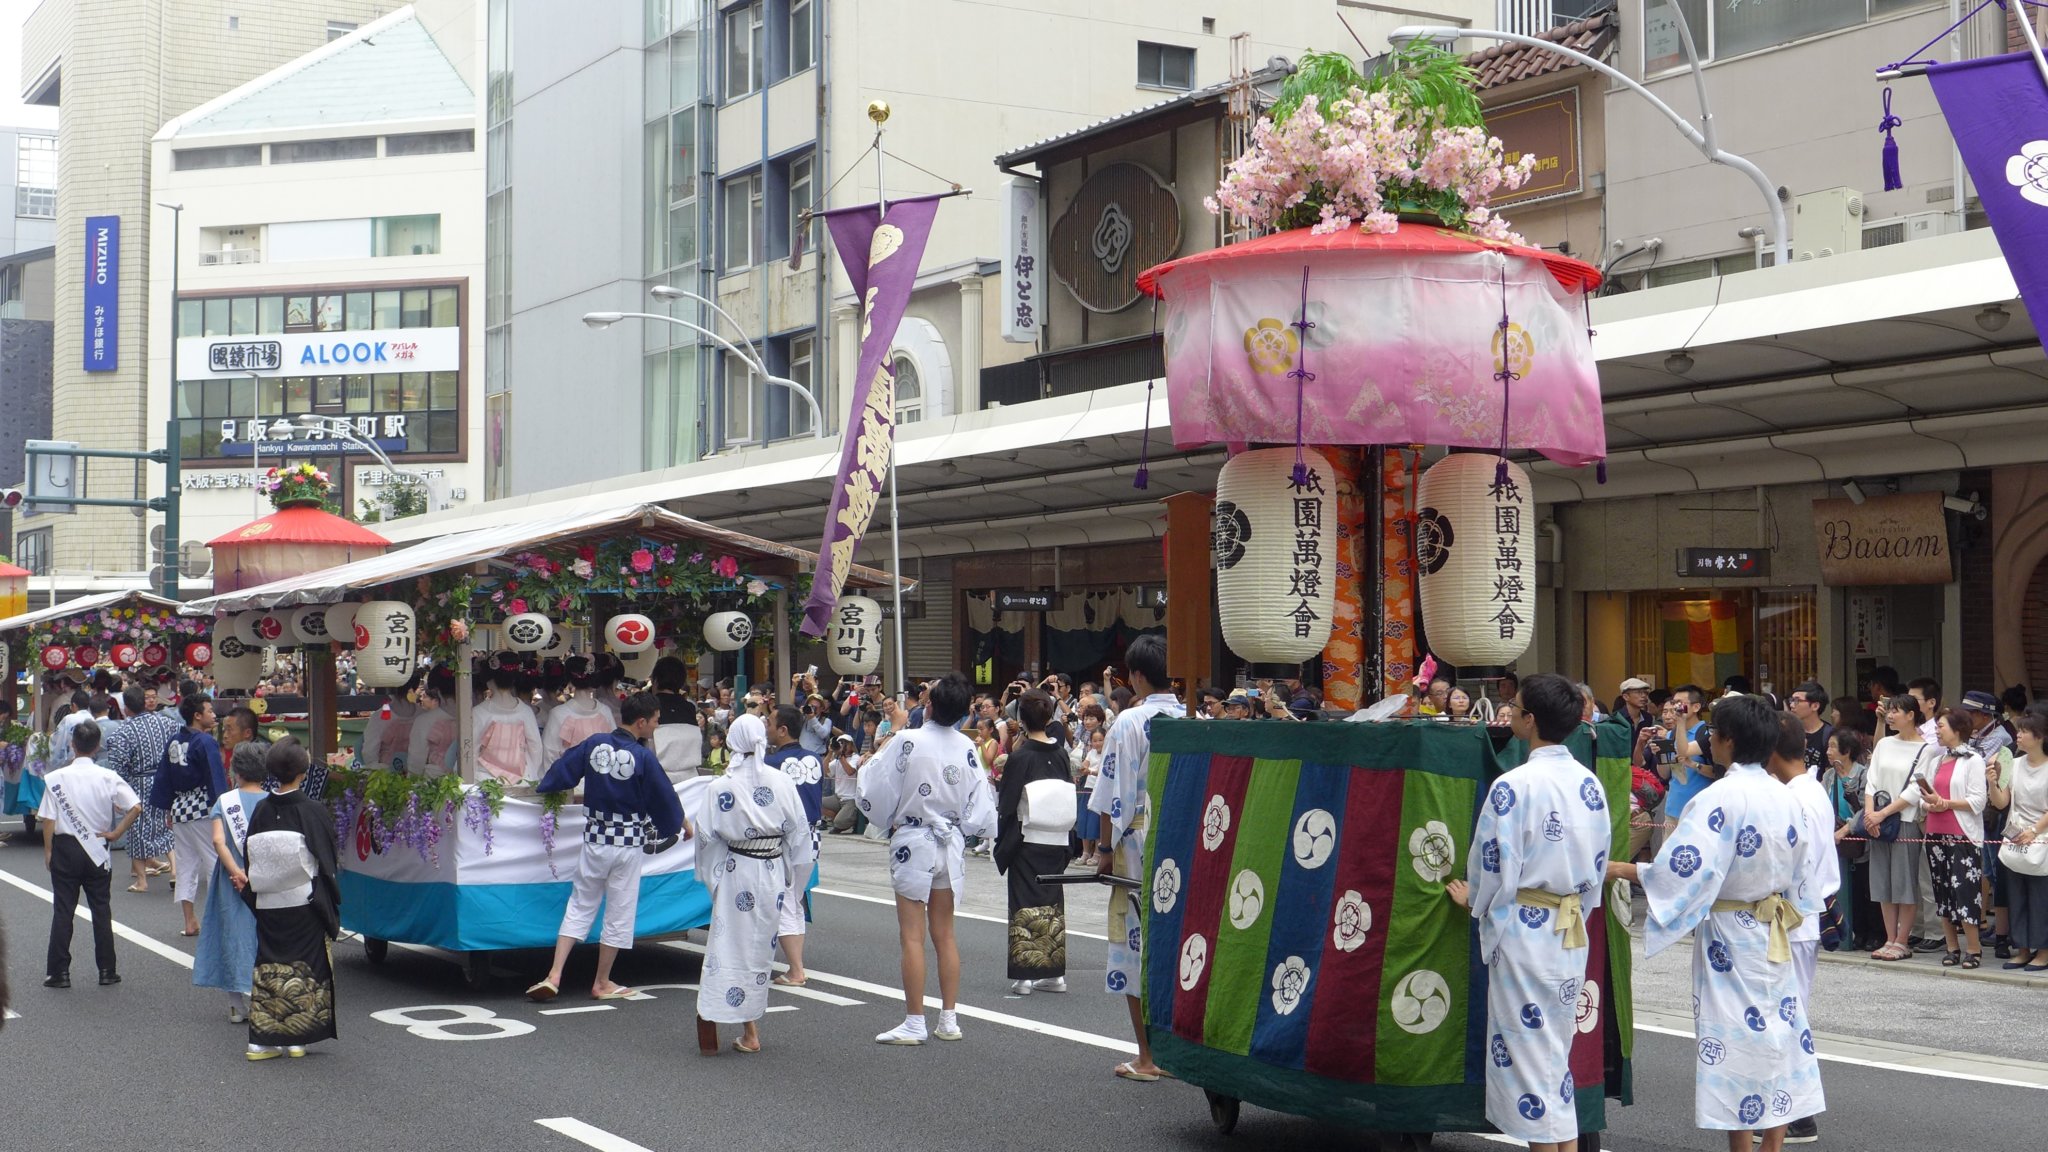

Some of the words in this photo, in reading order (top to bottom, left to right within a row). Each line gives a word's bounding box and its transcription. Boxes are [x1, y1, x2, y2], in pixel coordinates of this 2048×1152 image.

[96, 227, 109, 285] MIZUHO
[1014, 254, 1035, 329] 伊と忠
[94, 305, 105, 361] みずほ銀行
[212, 343, 278, 369] 眼鏡市場
[300, 341, 388, 365] ALOOK
[287, 442, 338, 452] Kawaramachi
[383, 611, 411, 675] 宮川町
[837, 603, 868, 663] 宮川町
